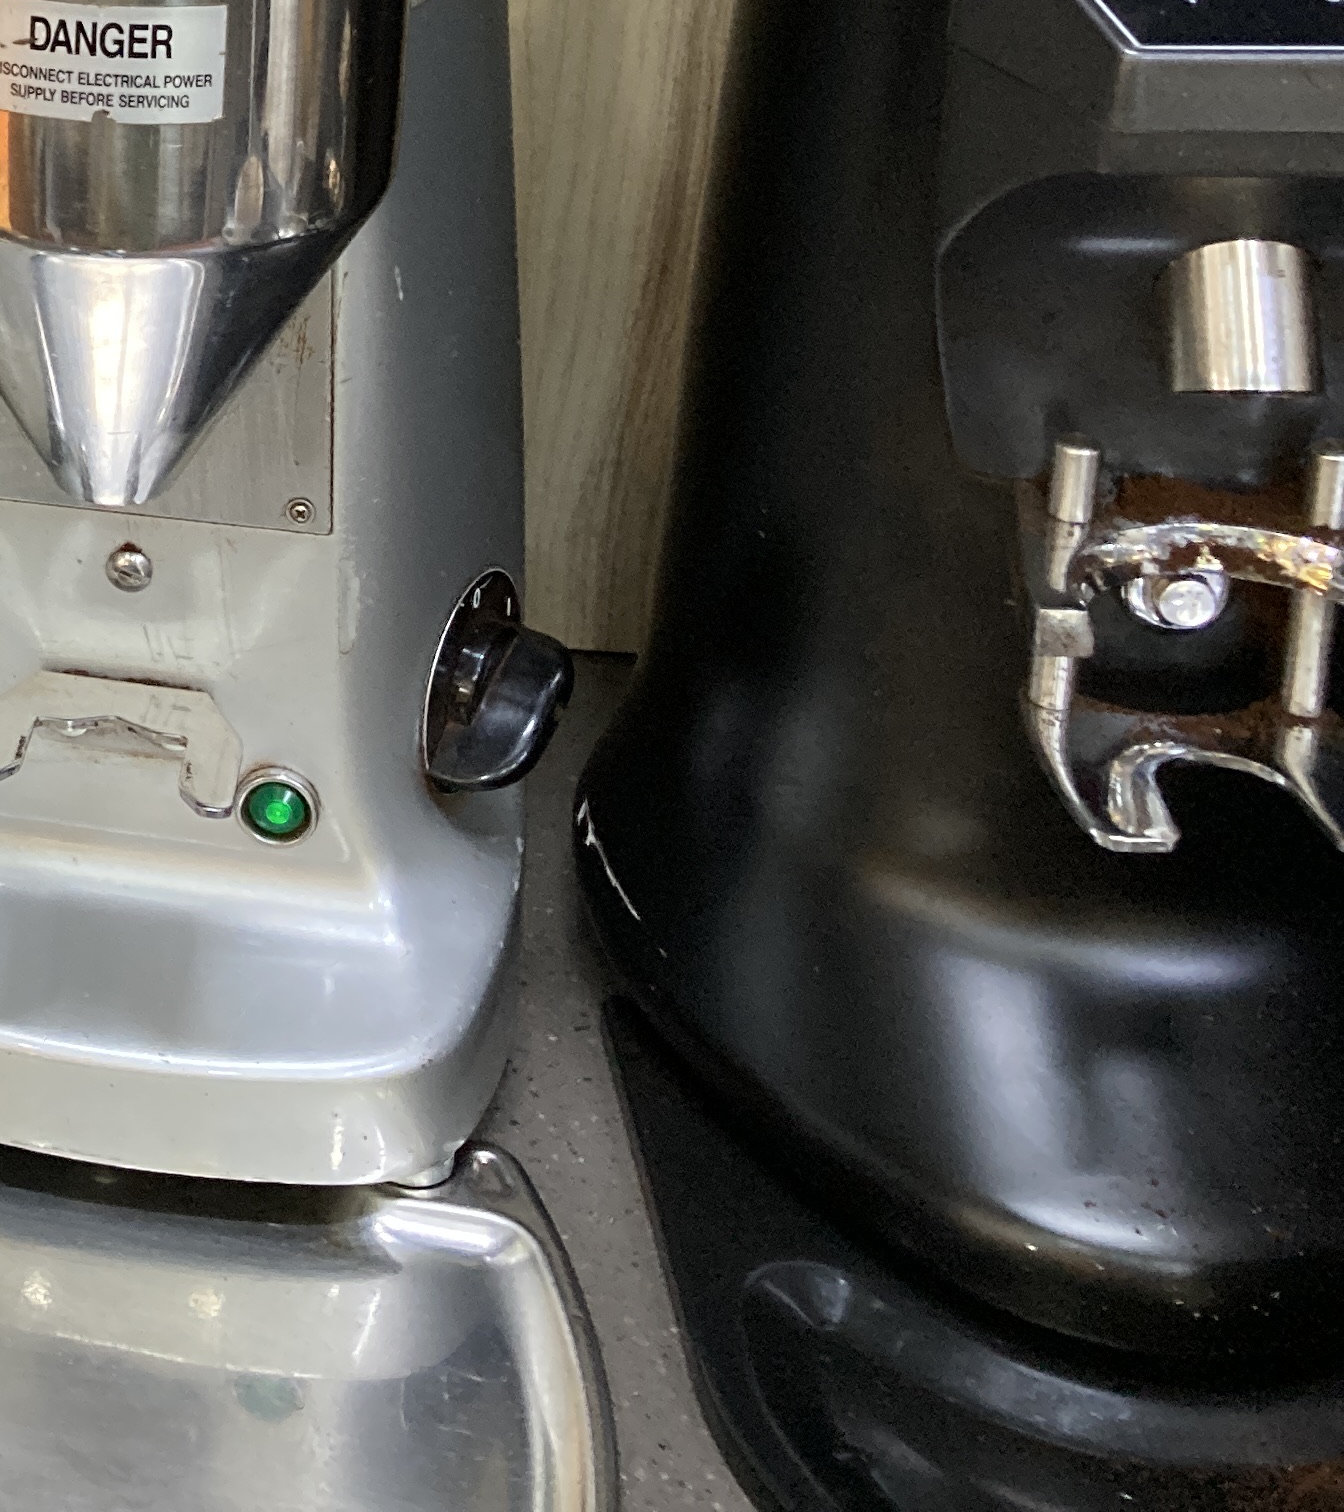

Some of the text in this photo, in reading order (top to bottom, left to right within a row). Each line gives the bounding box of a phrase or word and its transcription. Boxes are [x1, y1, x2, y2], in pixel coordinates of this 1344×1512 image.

[29, 16, 173, 59] DANGER
[78, 72, 160, 89] ELECTRICAL
[163, 74, 212, 88] POWER
[10, 83, 190, 109] SUPPLY BEFORE SERVICING
